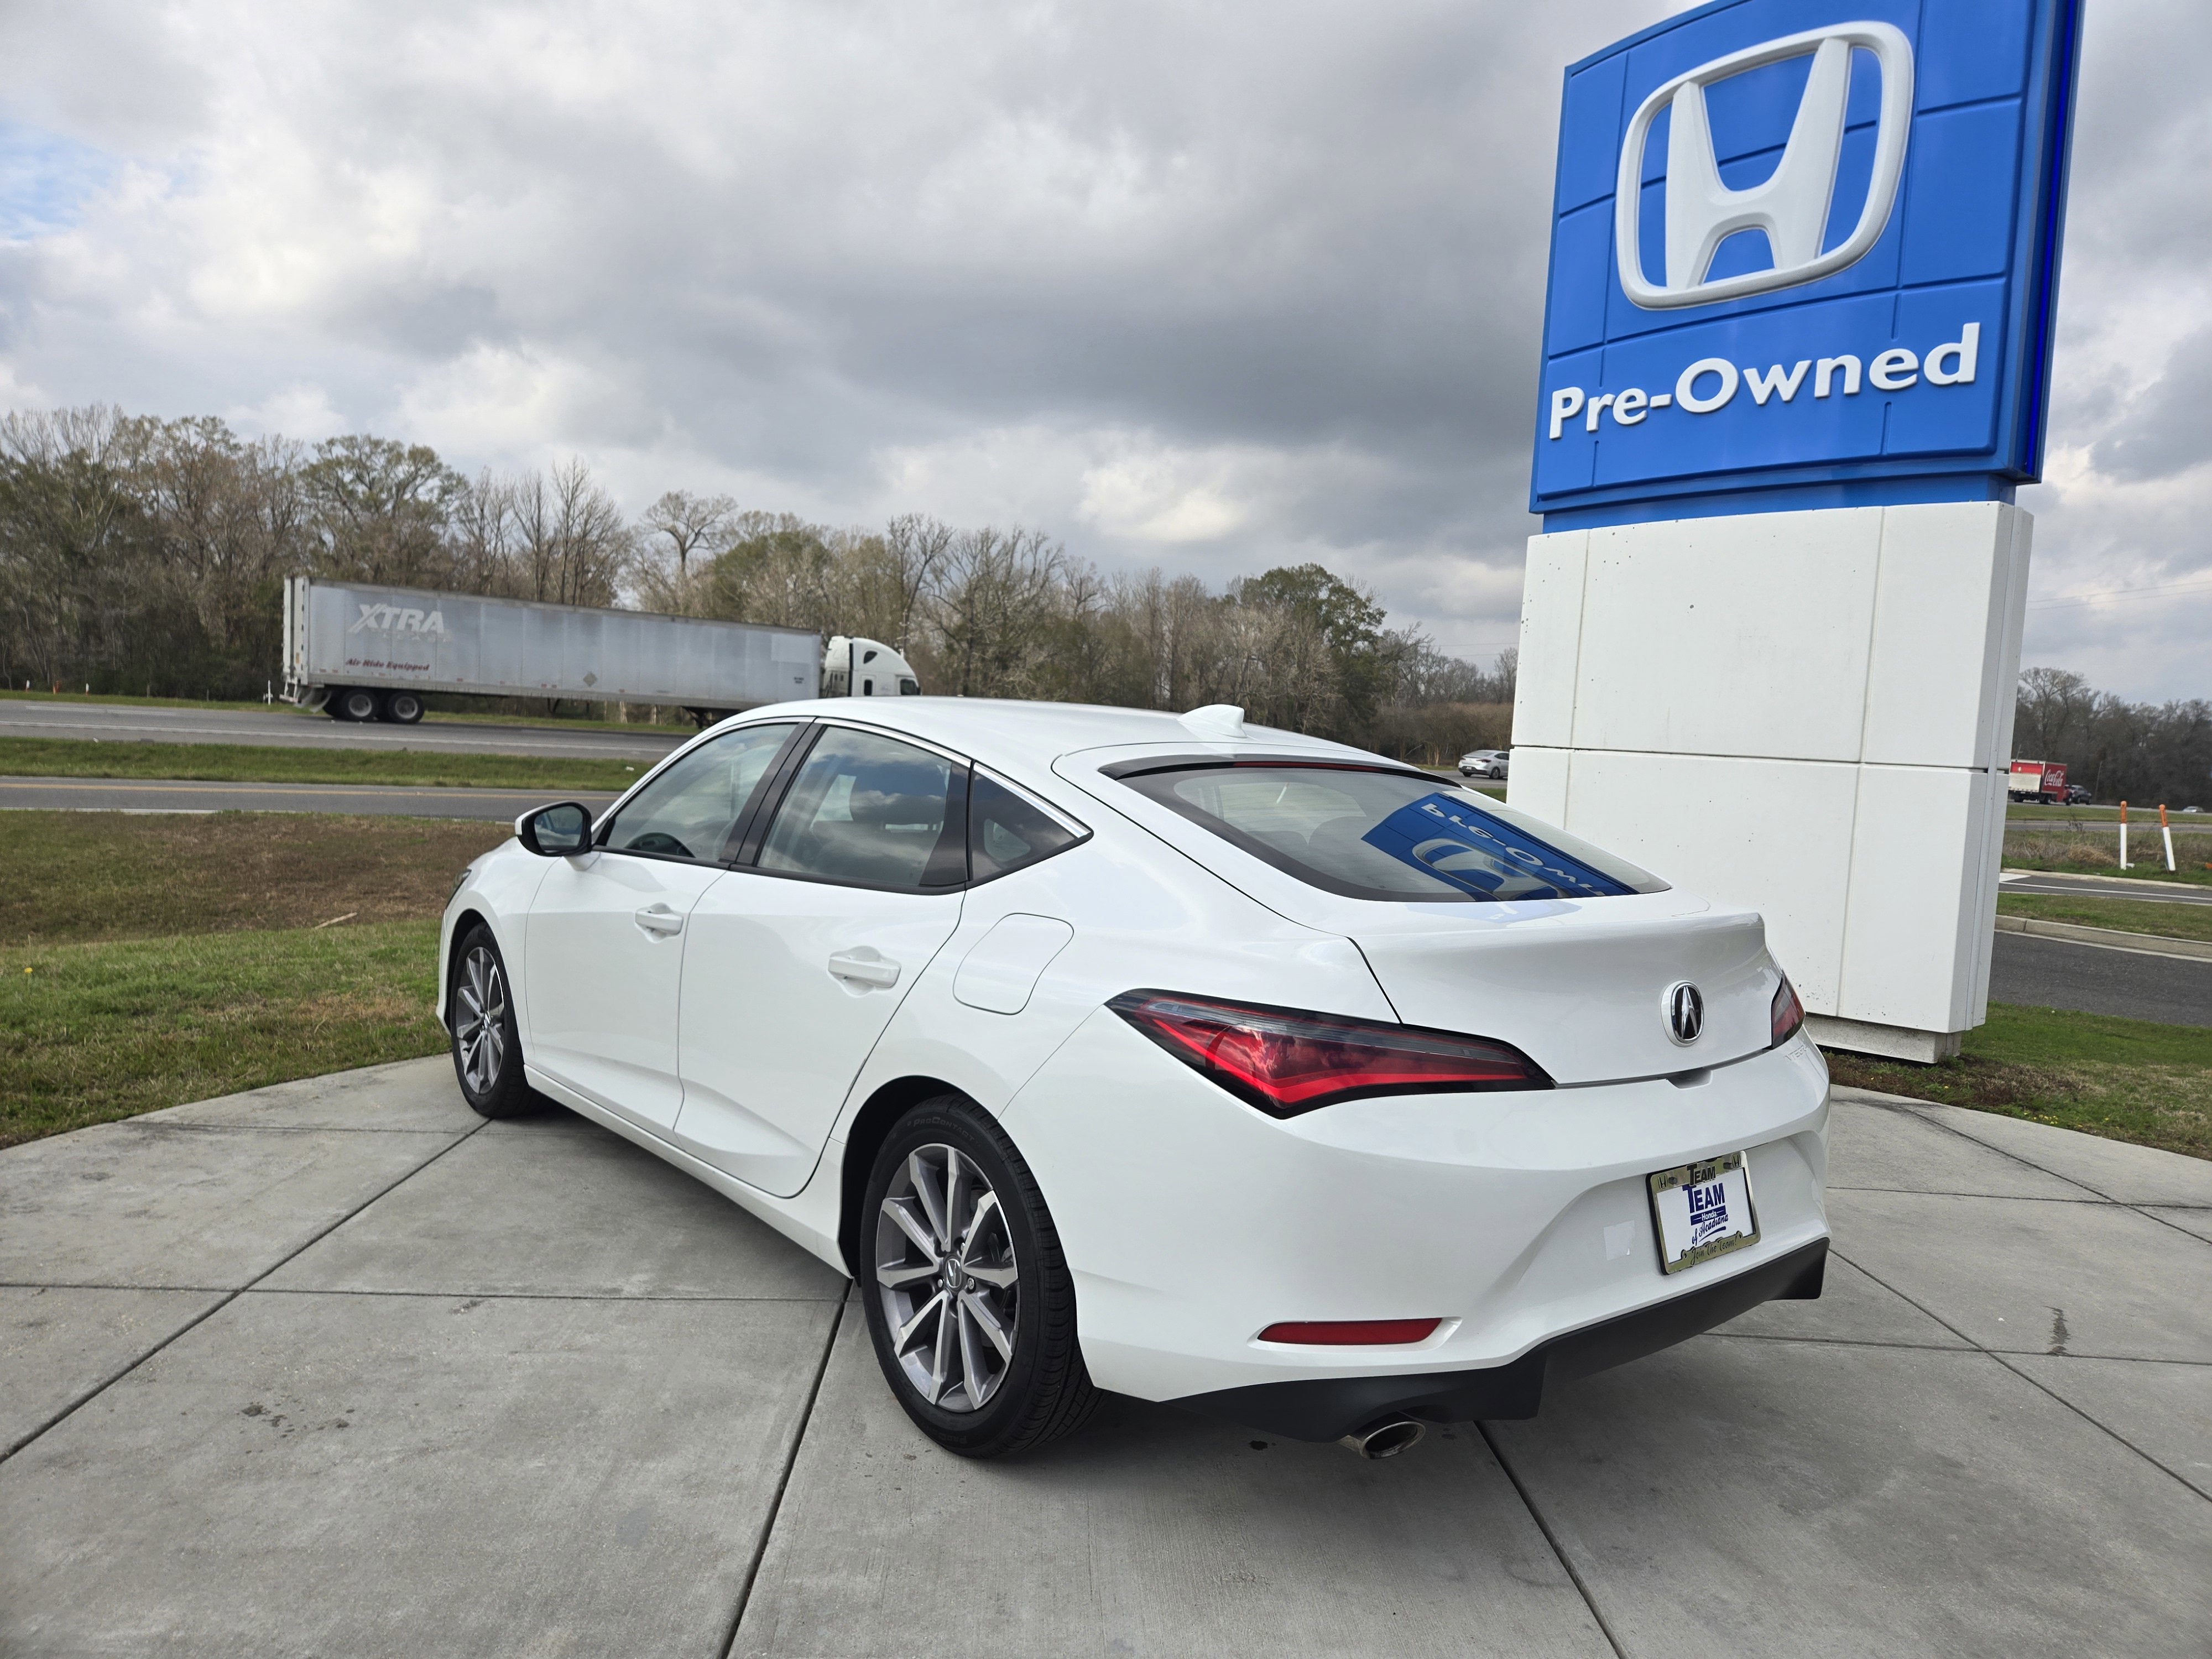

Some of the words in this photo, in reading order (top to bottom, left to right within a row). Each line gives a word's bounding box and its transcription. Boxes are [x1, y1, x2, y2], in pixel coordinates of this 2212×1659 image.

[1548, 322, 1981, 440] Pre-Owned
[347, 603, 444, 634] XTRA
[386, 661, 430, 671] Equipped
[1682, 1182, 1725, 1214] TEAM
[1692, 1228, 1698, 1246] of
[1699, 1214, 1729, 1237] Acadiana
[1701, 1210, 1718, 1221] Honda
[1691, 1247, 1704, 1266] Join
